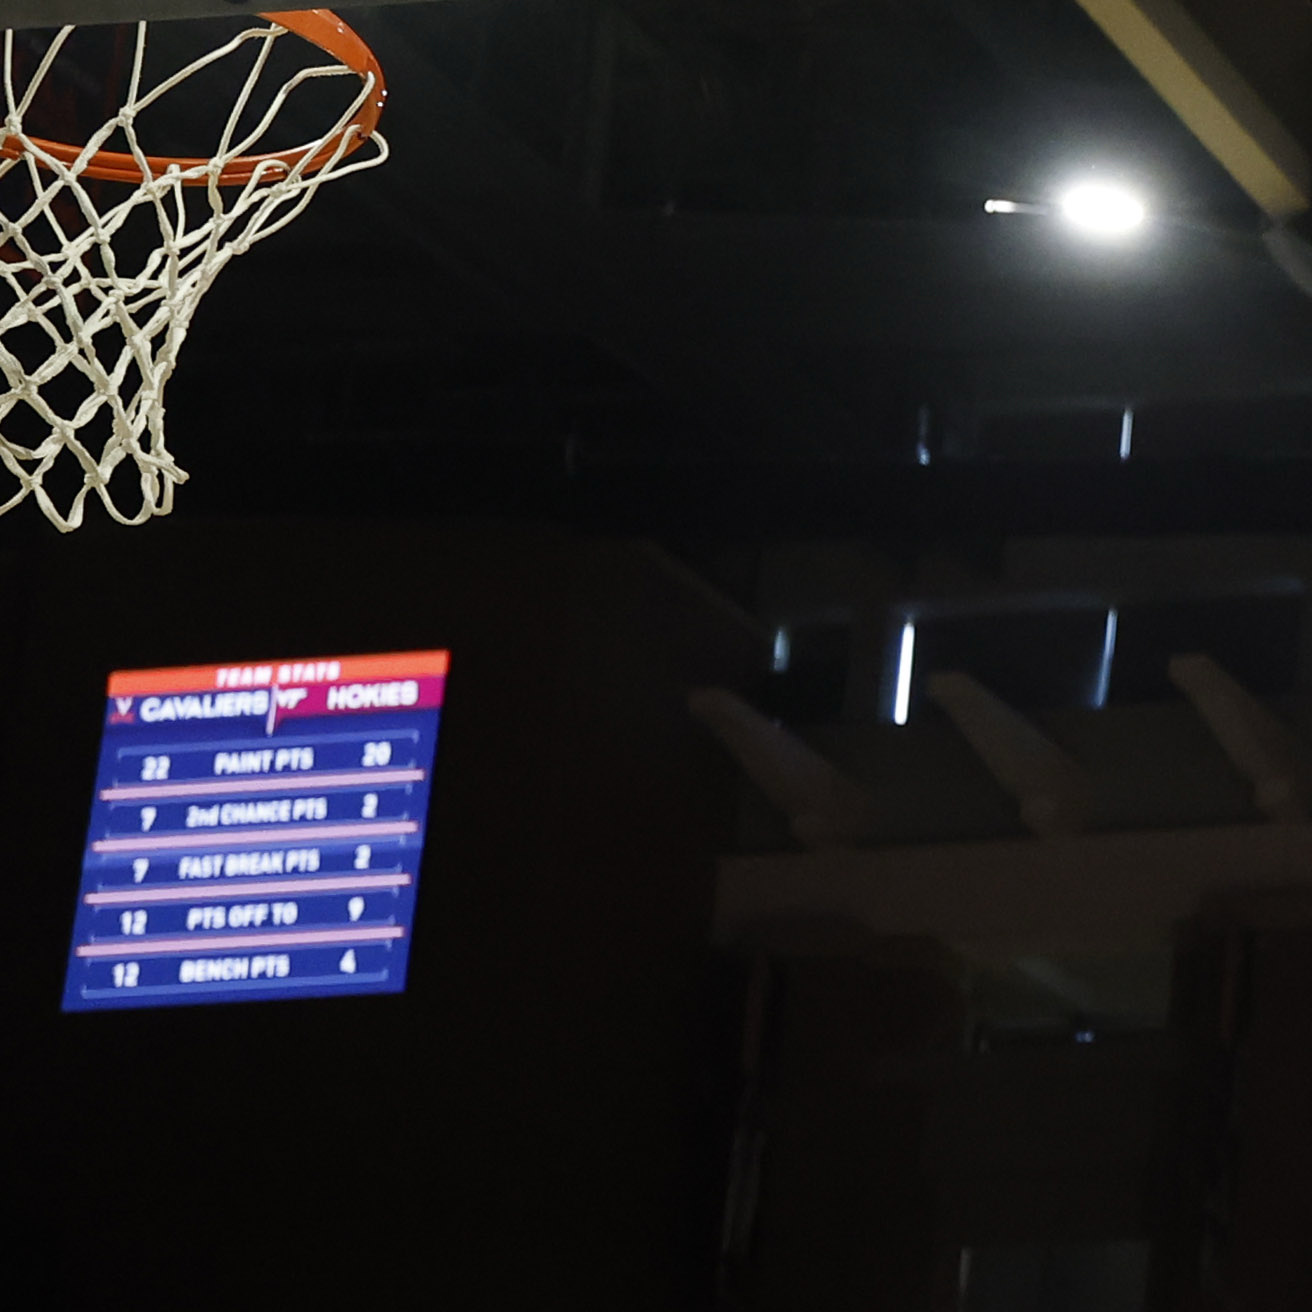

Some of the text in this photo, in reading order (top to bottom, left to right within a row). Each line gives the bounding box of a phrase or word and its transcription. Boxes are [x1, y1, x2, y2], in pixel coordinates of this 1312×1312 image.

[140, 690, 269, 723] CAVALIERS
[326, 681, 419, 710] HOKIES
[214, 750, 274, 775] PAINT
[275, 747, 315, 771] PTS
[141, 807, 157, 832] 7
[186, 805, 219, 828] 2nd
[220, 800, 291, 825] CHANCE
[293, 797, 327, 821] PTS
[133, 858, 149, 883] 7
[178, 855, 224, 880] FAST
[225, 852, 283, 877] BREAK
[286, 849, 320, 873] PTS
[120, 910, 147, 935] 12
[186, 906, 226, 931] PTS
[228, 904, 269, 928] OFF
[272, 902, 298, 926] TO
[113, 949, 356, 988] 12 BENCH PTS 4
